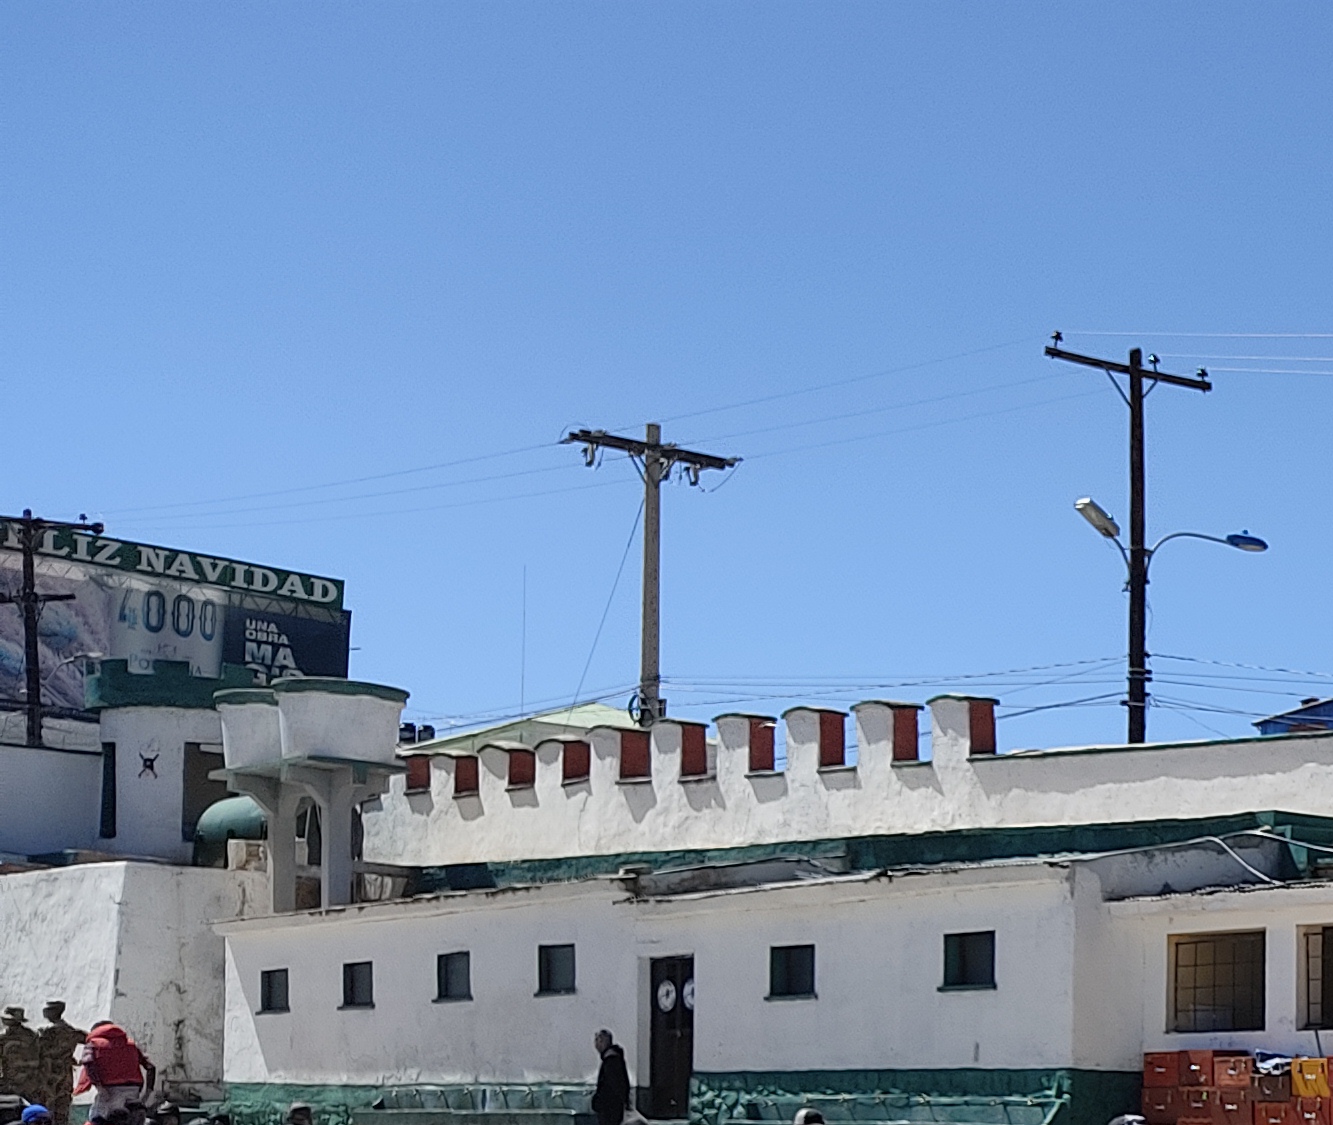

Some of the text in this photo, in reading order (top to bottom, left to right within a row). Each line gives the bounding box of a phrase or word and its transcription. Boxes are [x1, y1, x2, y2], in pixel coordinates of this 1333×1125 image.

[136, 546, 337, 603] NAVIDAD
[118, 589, 216, 641] 4000
[246, 618, 278, 633] UNA
[245, 629, 289, 645] OBRA
[245, 641, 297, 669] MA
